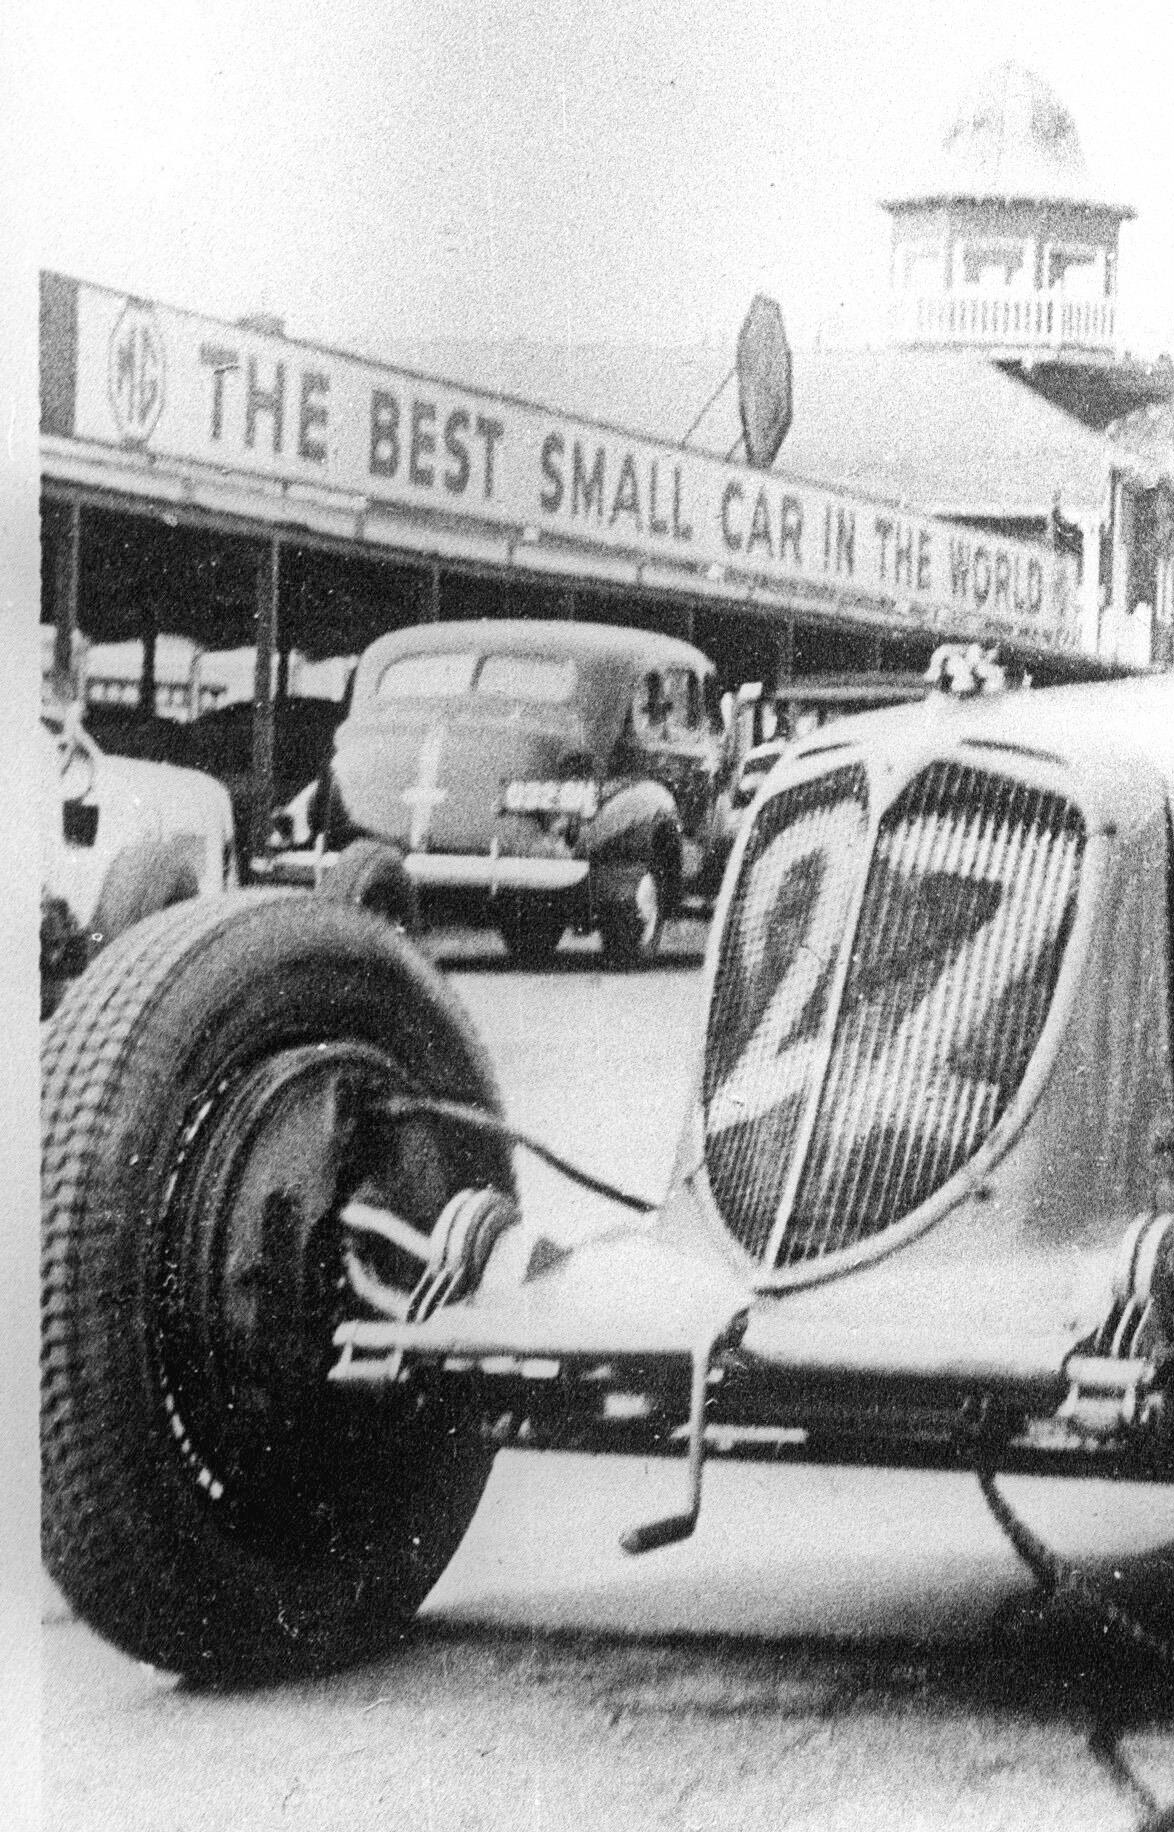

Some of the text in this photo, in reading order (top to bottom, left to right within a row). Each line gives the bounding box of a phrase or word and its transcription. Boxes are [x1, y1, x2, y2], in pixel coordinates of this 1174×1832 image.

[115, 322, 162, 430] MG
[200, 342, 331, 462] THE
[368, 388, 504, 499] BEST
[540, 432, 694, 541] SMALL
[720, 480, 803, 563] CAR
[824, 505, 855, 576] IN
[875, 516, 931, 591] THE
[949, 537, 1043, 614] WORLD
